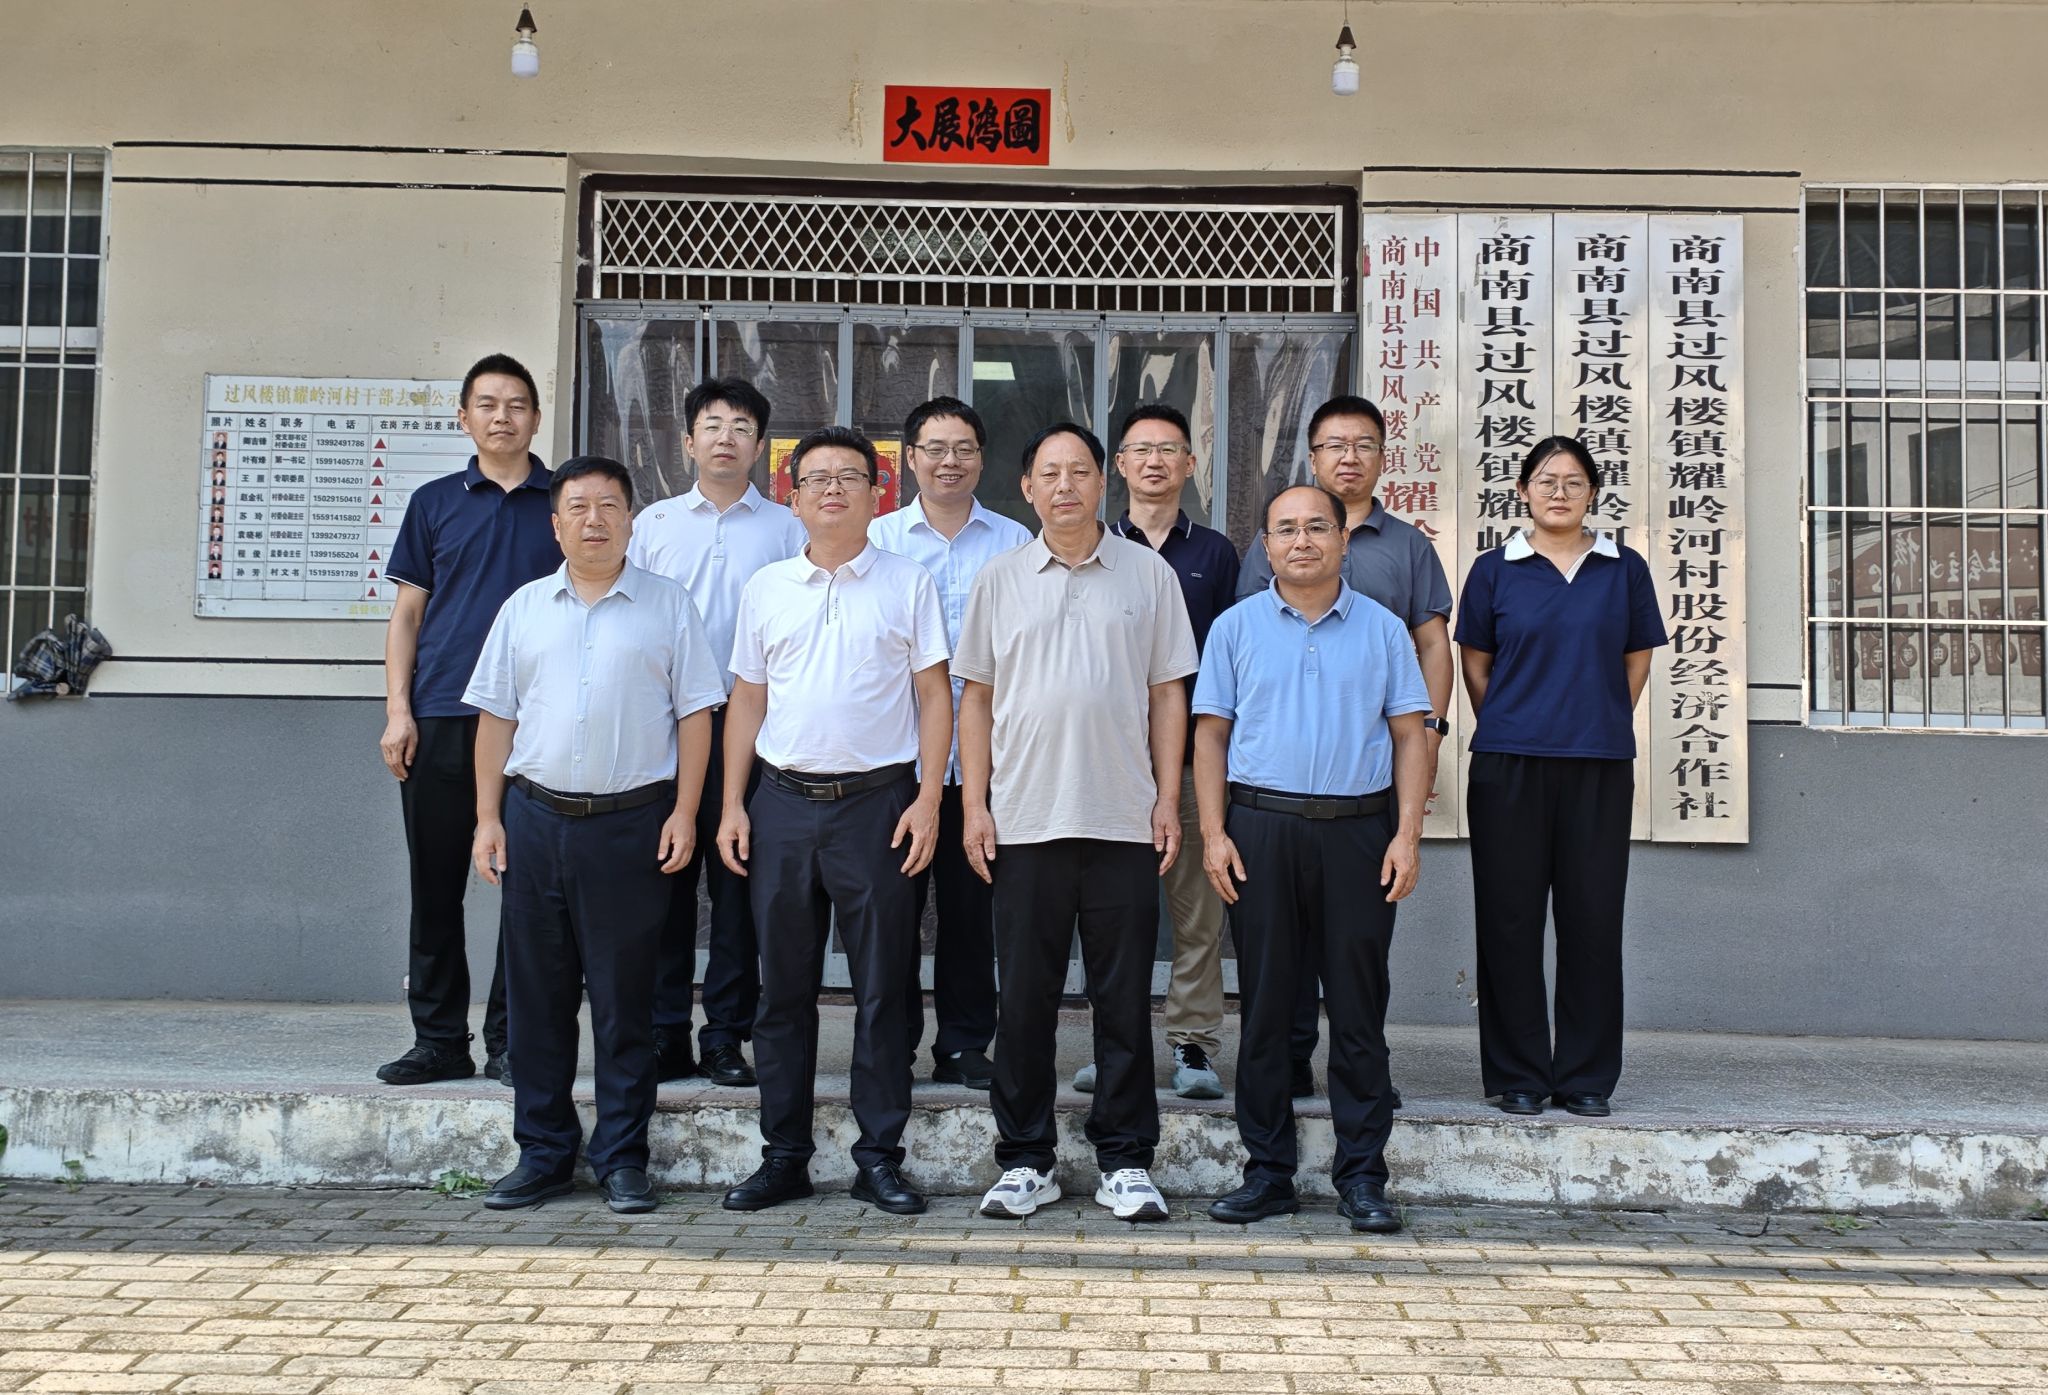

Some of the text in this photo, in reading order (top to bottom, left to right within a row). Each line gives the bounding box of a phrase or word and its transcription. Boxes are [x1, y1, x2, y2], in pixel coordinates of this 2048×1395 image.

[890, 95, 1042, 154] 大展鸿圖
[1378, 234, 1408, 476] 商南县过风楼镇
[1413, 235, 1441, 474] 中国共产党
[211, 416, 232, 427] 照片
[244, 418, 267, 429] 姓名
[280, 417, 303, 428] 职务
[327, 419, 356, 430] 电话
[380, 420, 397, 430] 在岗
[402, 420, 420, 430] 开会
[424, 420, 442, 431] 出差
[274, 433, 308, 442] 党支部书记
[274, 441, 307, 450] 村委会主任
[316, 438, 365, 448] 13992491786
[274, 455, 306, 465] 第一书记
[314, 457, 364, 467] 15991405778
[273, 474, 305, 484] 专职委员
[271, 493, 306, 502] 村委会副主任
[270, 511, 305, 521] 村委会副主任
[1665, 234, 1731, 821] 商南县过风楼镇耀岭河村股份经济合作社
[270, 530, 304, 539] 村委会副主任
[311, 531, 360, 541] 13992479737
[270, 567, 300, 577] 村文书
[308, 568, 359, 578] 15191591789
